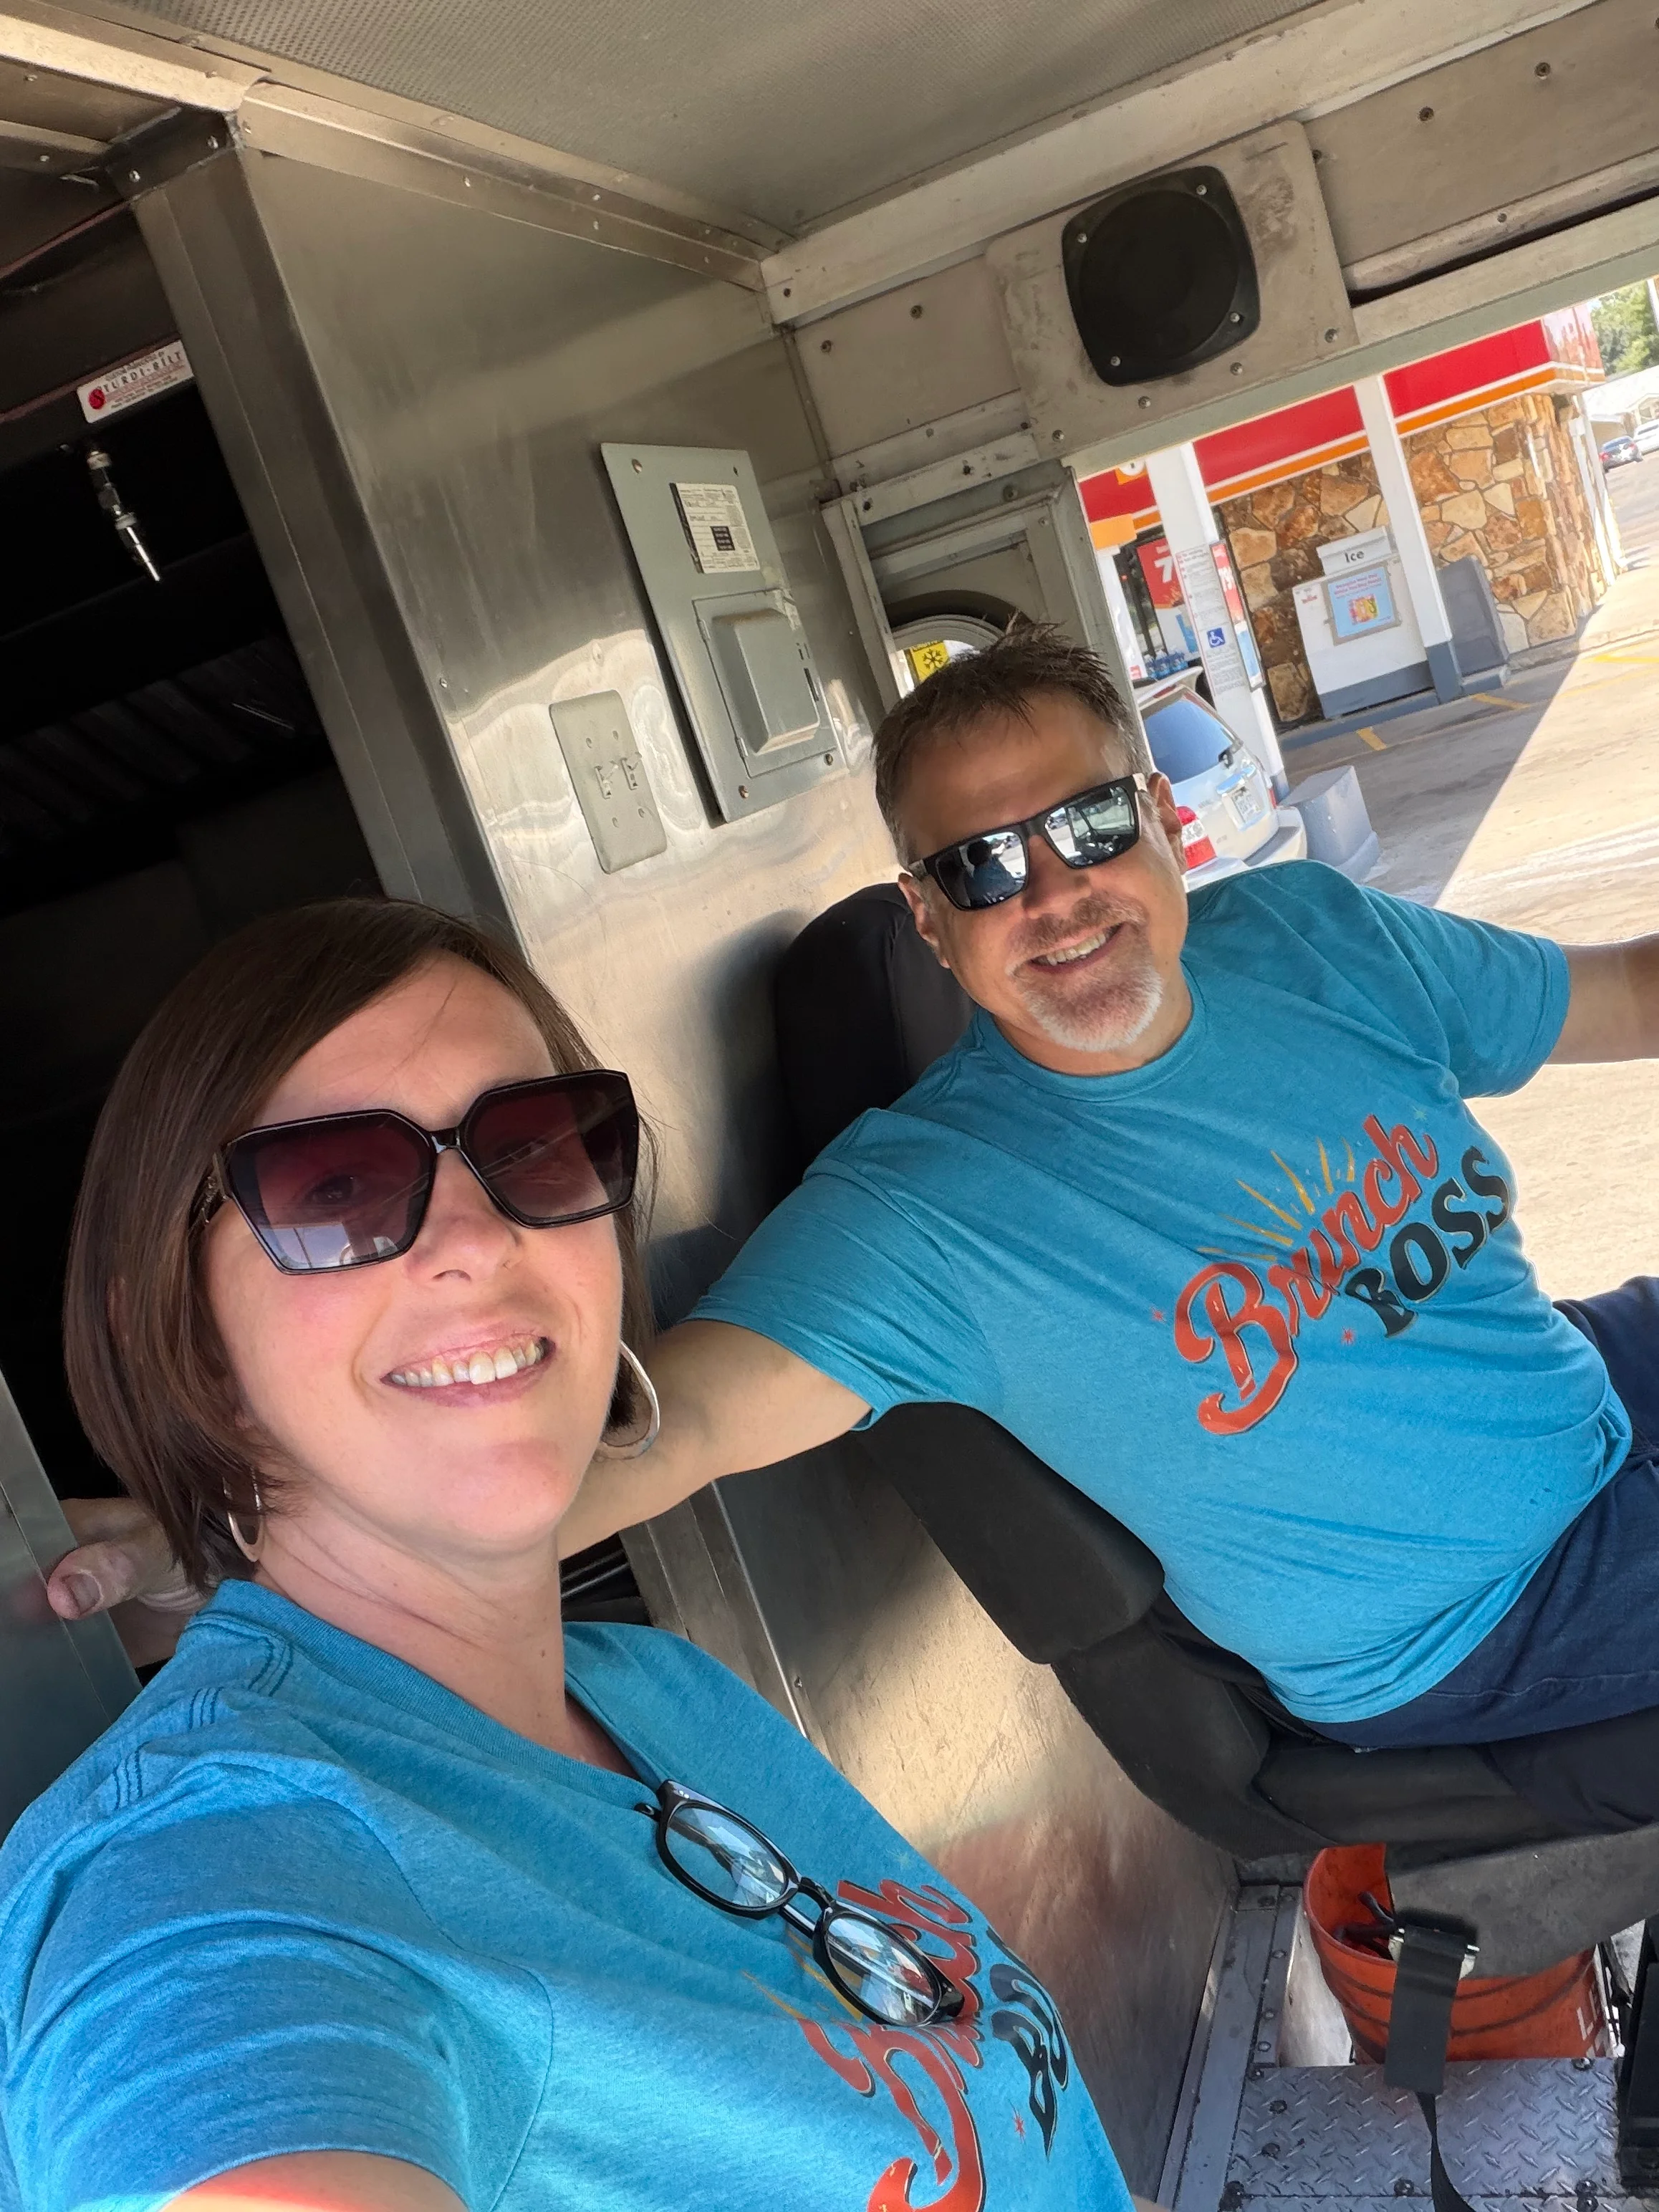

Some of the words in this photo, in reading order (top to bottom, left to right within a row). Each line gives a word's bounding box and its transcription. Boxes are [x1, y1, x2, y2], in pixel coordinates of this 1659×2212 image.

[1345, 551, 1365, 563] Ice
[1173, 1114, 1439, 1435] Brunch
[1345, 1145, 1510, 1338] BOSS
